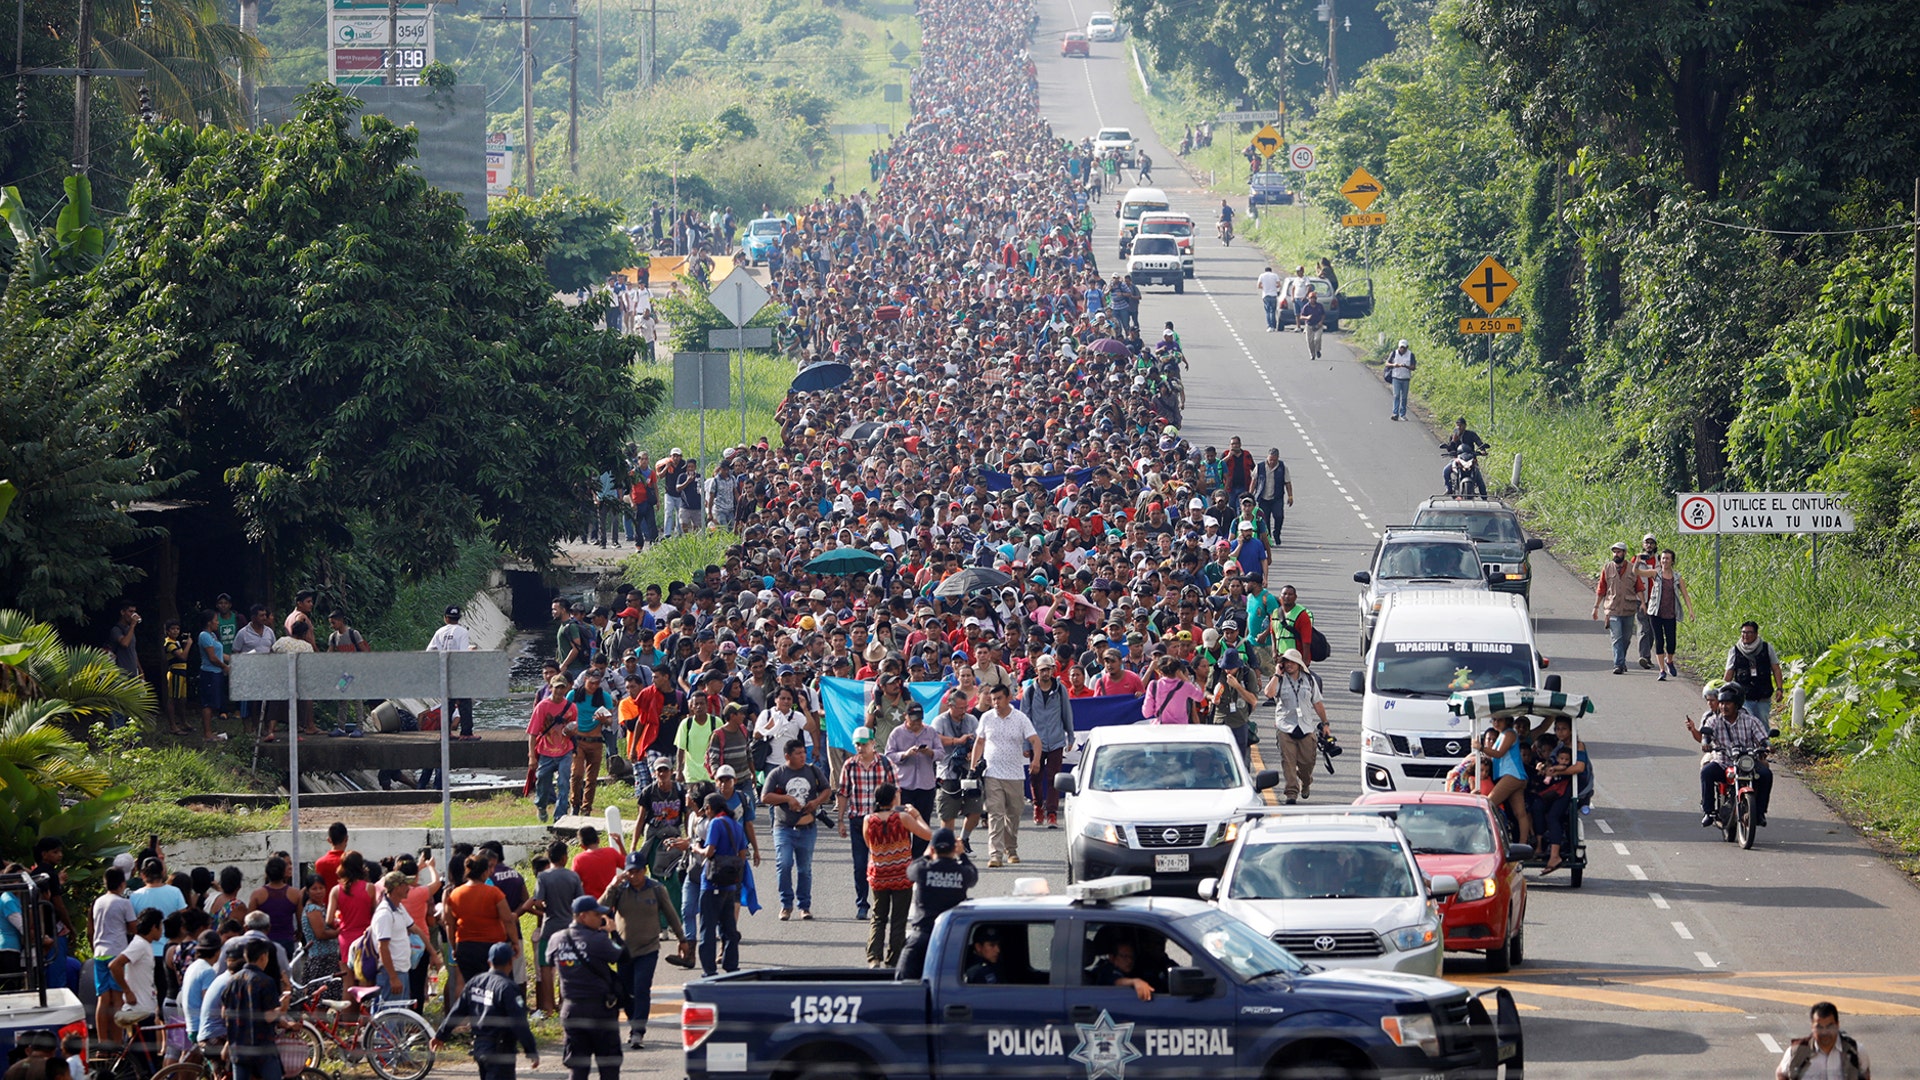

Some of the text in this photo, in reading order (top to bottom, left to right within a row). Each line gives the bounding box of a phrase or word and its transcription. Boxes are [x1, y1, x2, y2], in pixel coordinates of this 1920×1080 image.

[398, 25, 424, 37] 3549
[1296, 151, 1309, 161] 40
[1347, 216, 1353, 224] A
[1357, 215, 1371, 223] 150
[1466, 321, 1474, 331] A
[1480, 320, 1501, 331] 250
[1723, 497, 1844, 511] UTILICE EL CINTURO
[1732, 515, 1843, 528] SALVA TU VIDA
[1395, 642, 1449, 653] TAPACHULA
[1472, 643, 1513, 654] HIDALGO
[1384, 700, 1396, 710] 04
[926, 880, 963, 889] FEDERAL
[791, 996, 863, 1024] 15327
[988, 1024, 1064, 1055] POLICÍA
[1146, 1028, 1233, 1056] FEDERAL
